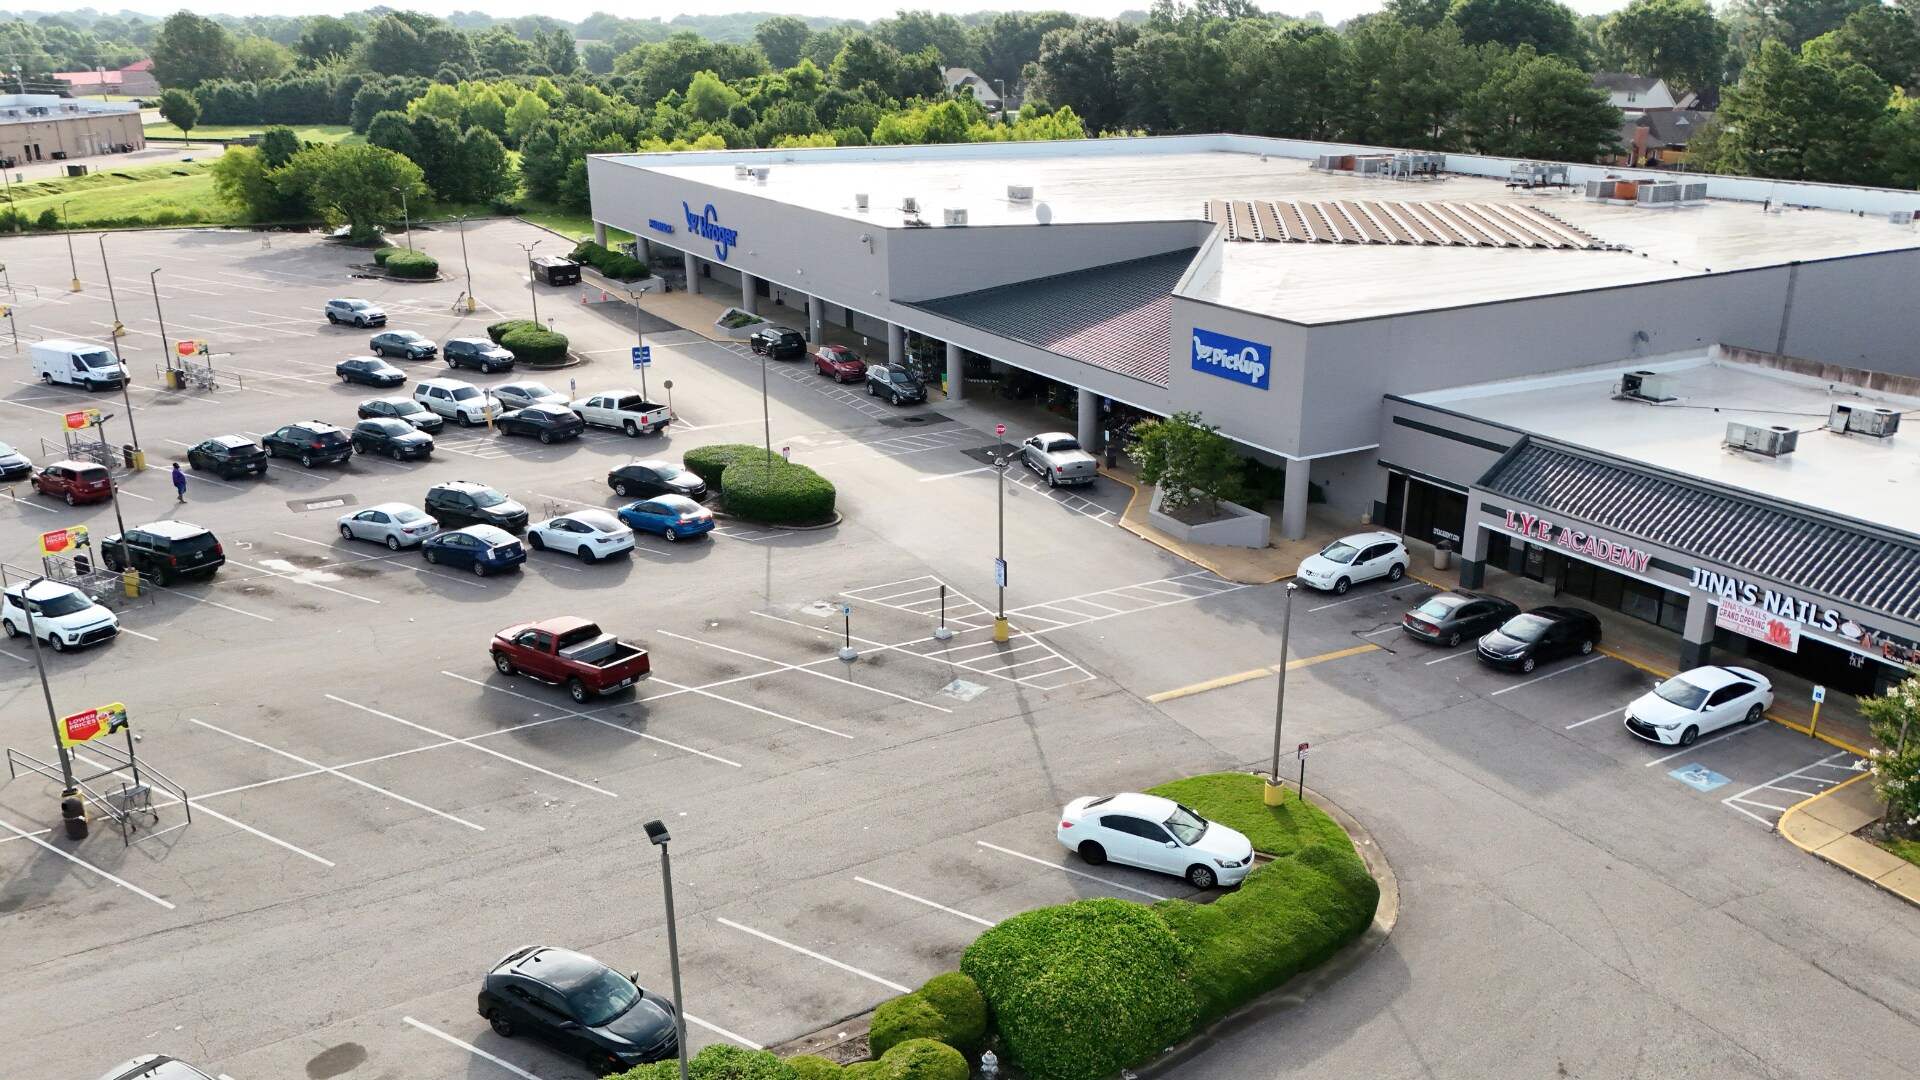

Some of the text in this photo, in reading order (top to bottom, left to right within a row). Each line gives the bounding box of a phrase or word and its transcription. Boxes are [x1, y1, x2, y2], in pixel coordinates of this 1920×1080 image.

[700, 204, 738, 261] Kroger
[1213, 347, 1265, 384] Pickup
[46, 536, 66, 544] PRICES
[1557, 527, 1652, 573] ACADEMY
[1689, 566, 1841, 633] JINA'S NAILS
[1721, 600, 1767, 620] JINA'S NAILS
[1719, 608, 1765, 630] GRAND OPENING
[69, 714, 95, 725] LOWER
[69, 718, 96, 731] PRICES
